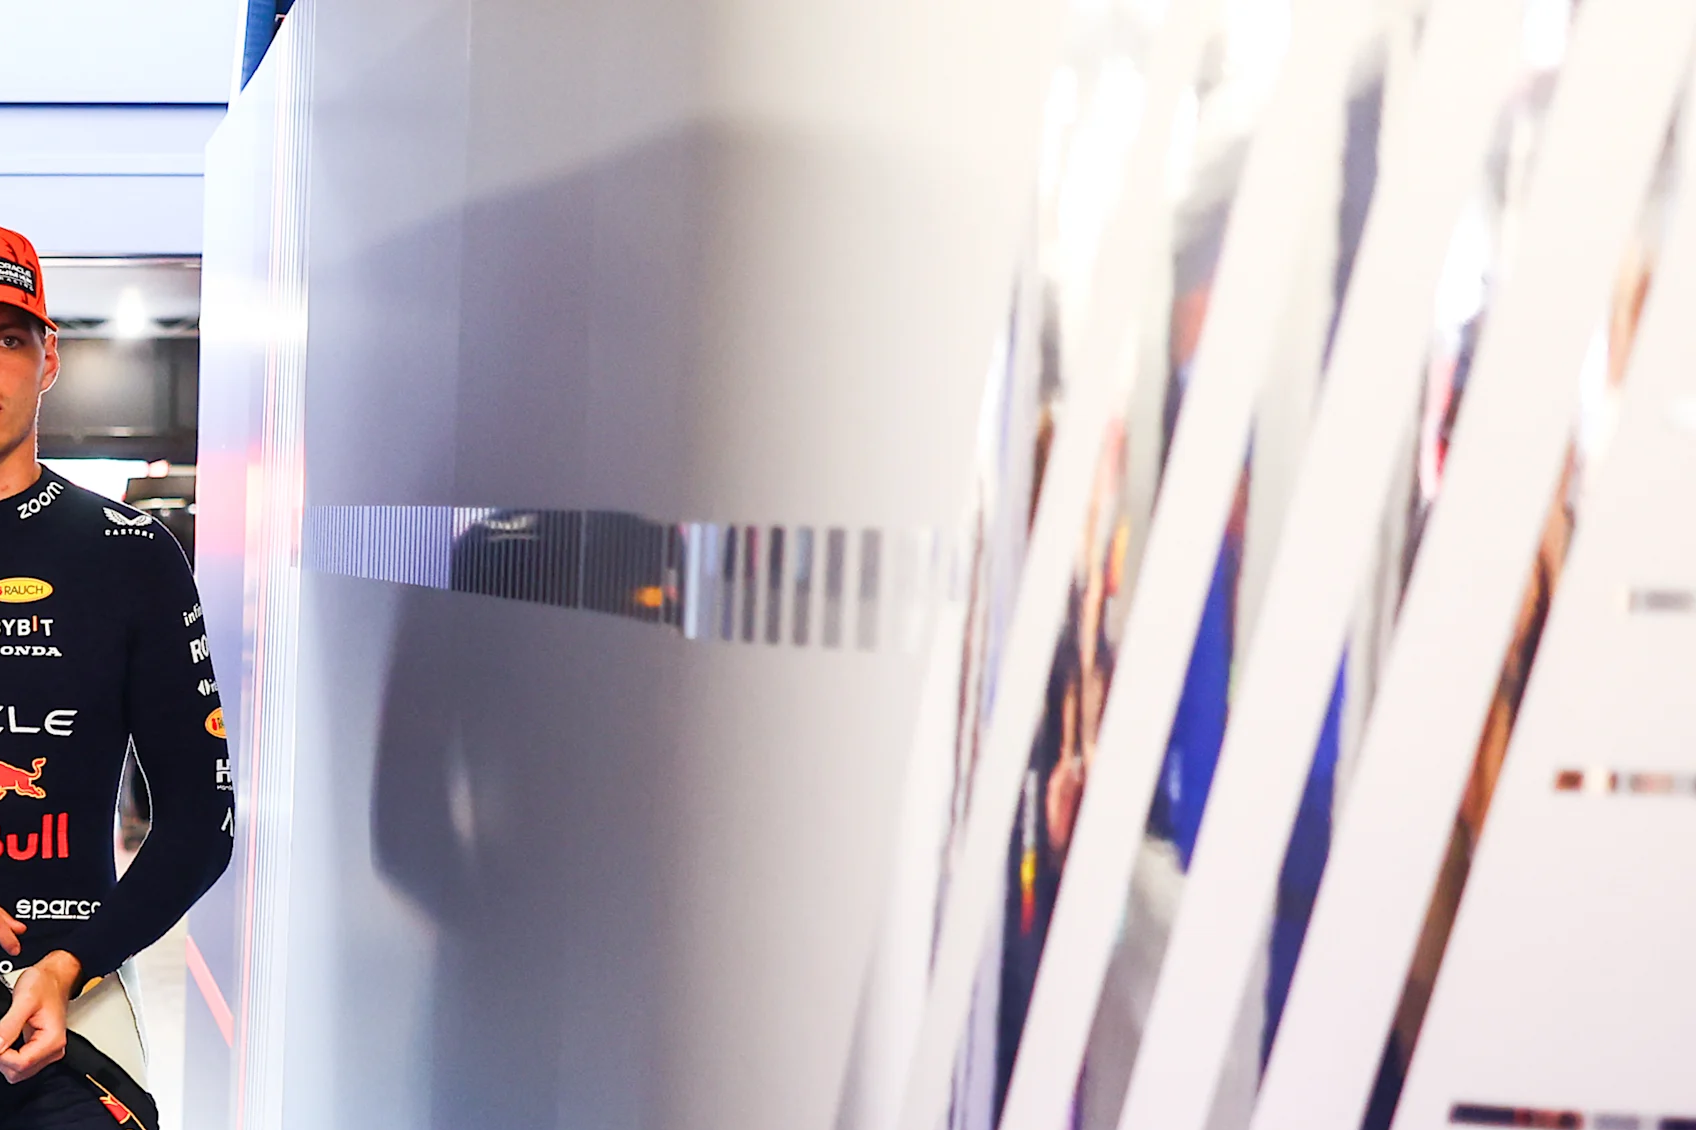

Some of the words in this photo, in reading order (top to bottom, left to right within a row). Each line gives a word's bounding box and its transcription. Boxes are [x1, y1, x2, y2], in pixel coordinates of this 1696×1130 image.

[17, 481, 64, 520] zoom
[104, 528, 154, 539] CASTORE
[4, 585, 44, 597] RAUCH
